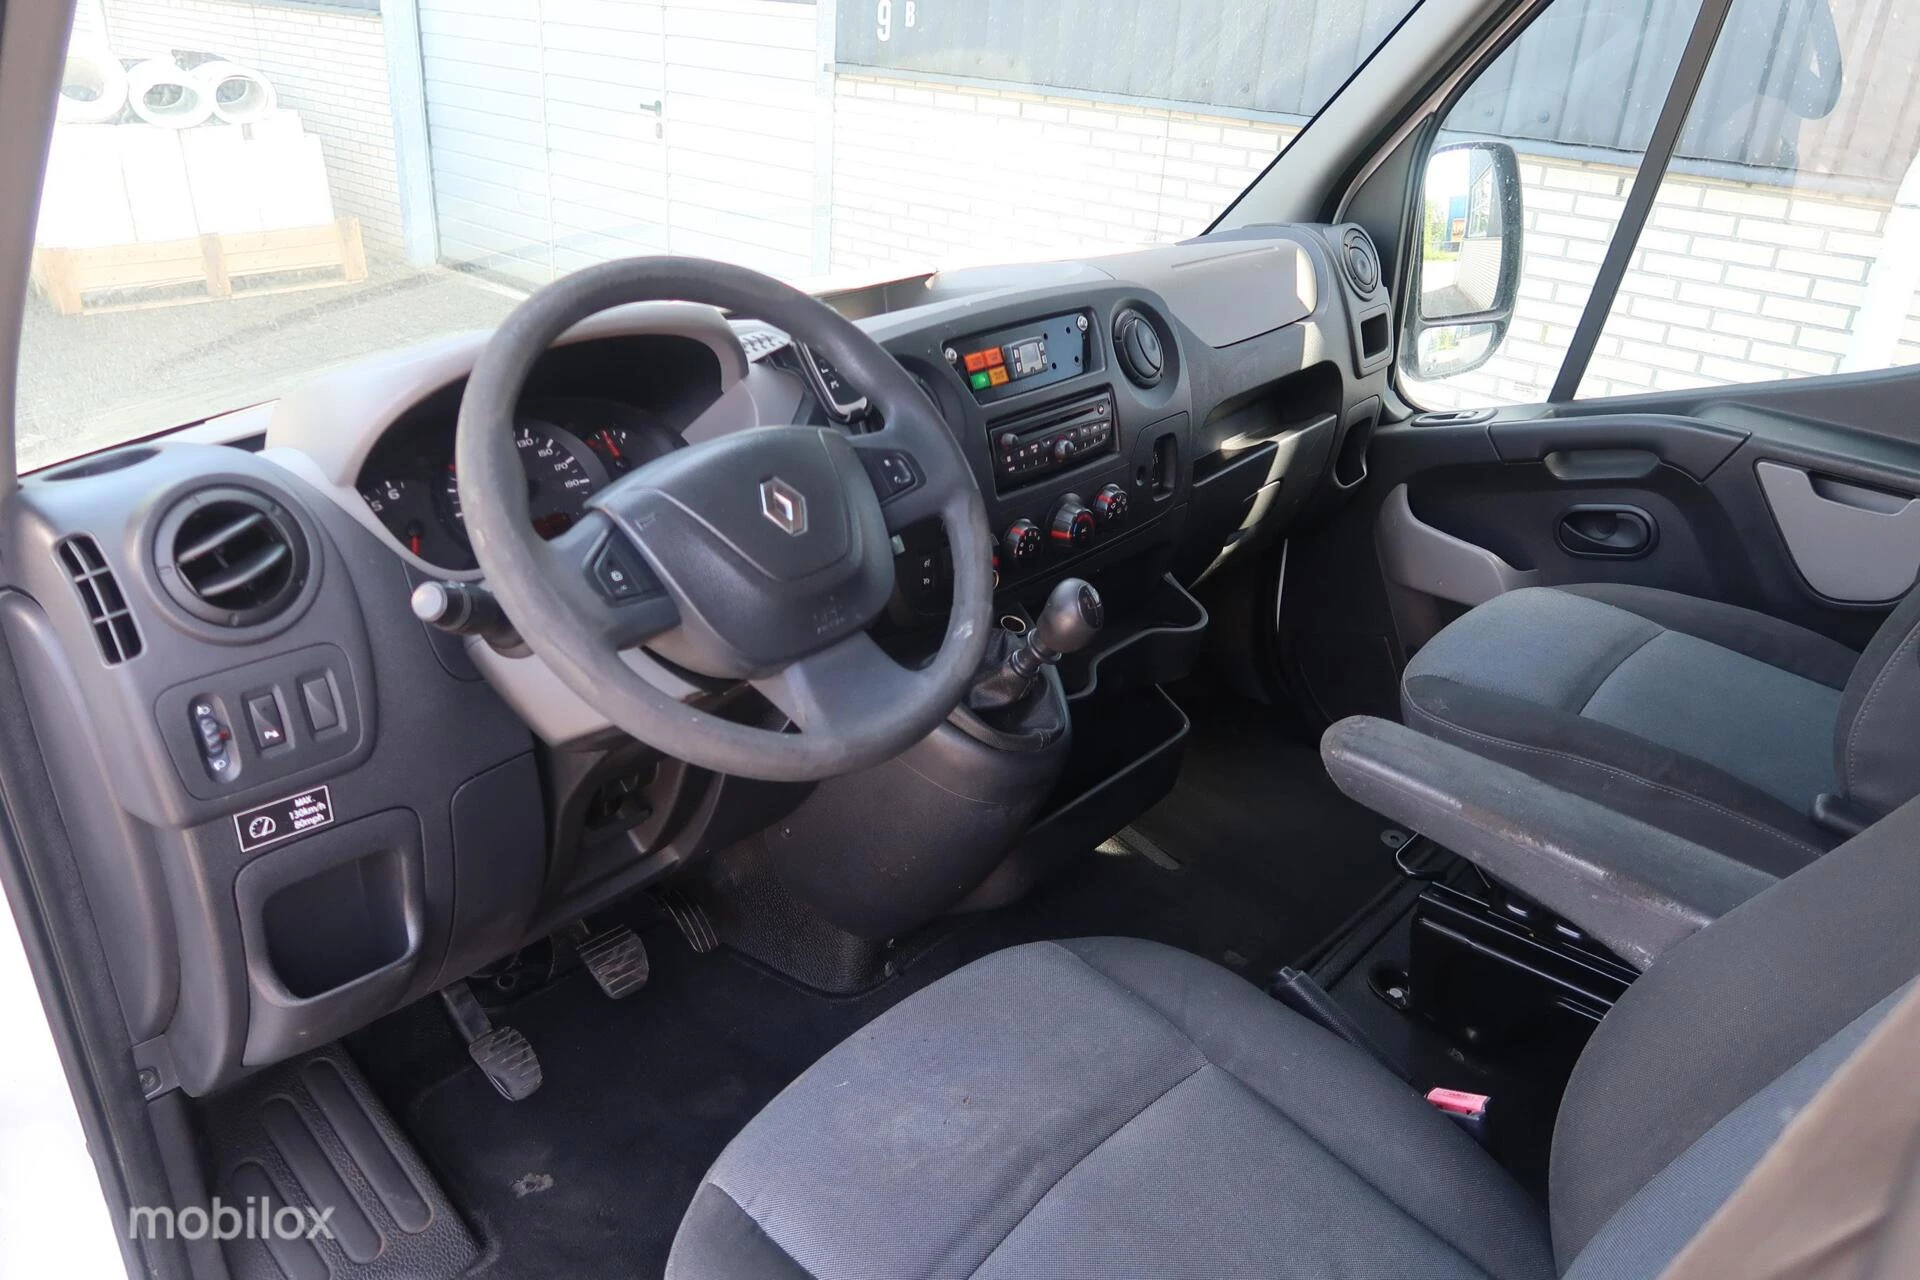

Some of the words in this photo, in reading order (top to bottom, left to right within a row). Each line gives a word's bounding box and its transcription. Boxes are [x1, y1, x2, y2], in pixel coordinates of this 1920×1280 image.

[876, 0, 891, 41] 9
[904, 0, 916, 28] B
[517, 438, 533, 448] 130
[554, 462, 568, 471] 170
[387, 488, 400, 500] 6
[371, 500, 383, 512] 5
[288, 802, 326, 820] 130km/h
[294, 813, 325, 829] 80mph
